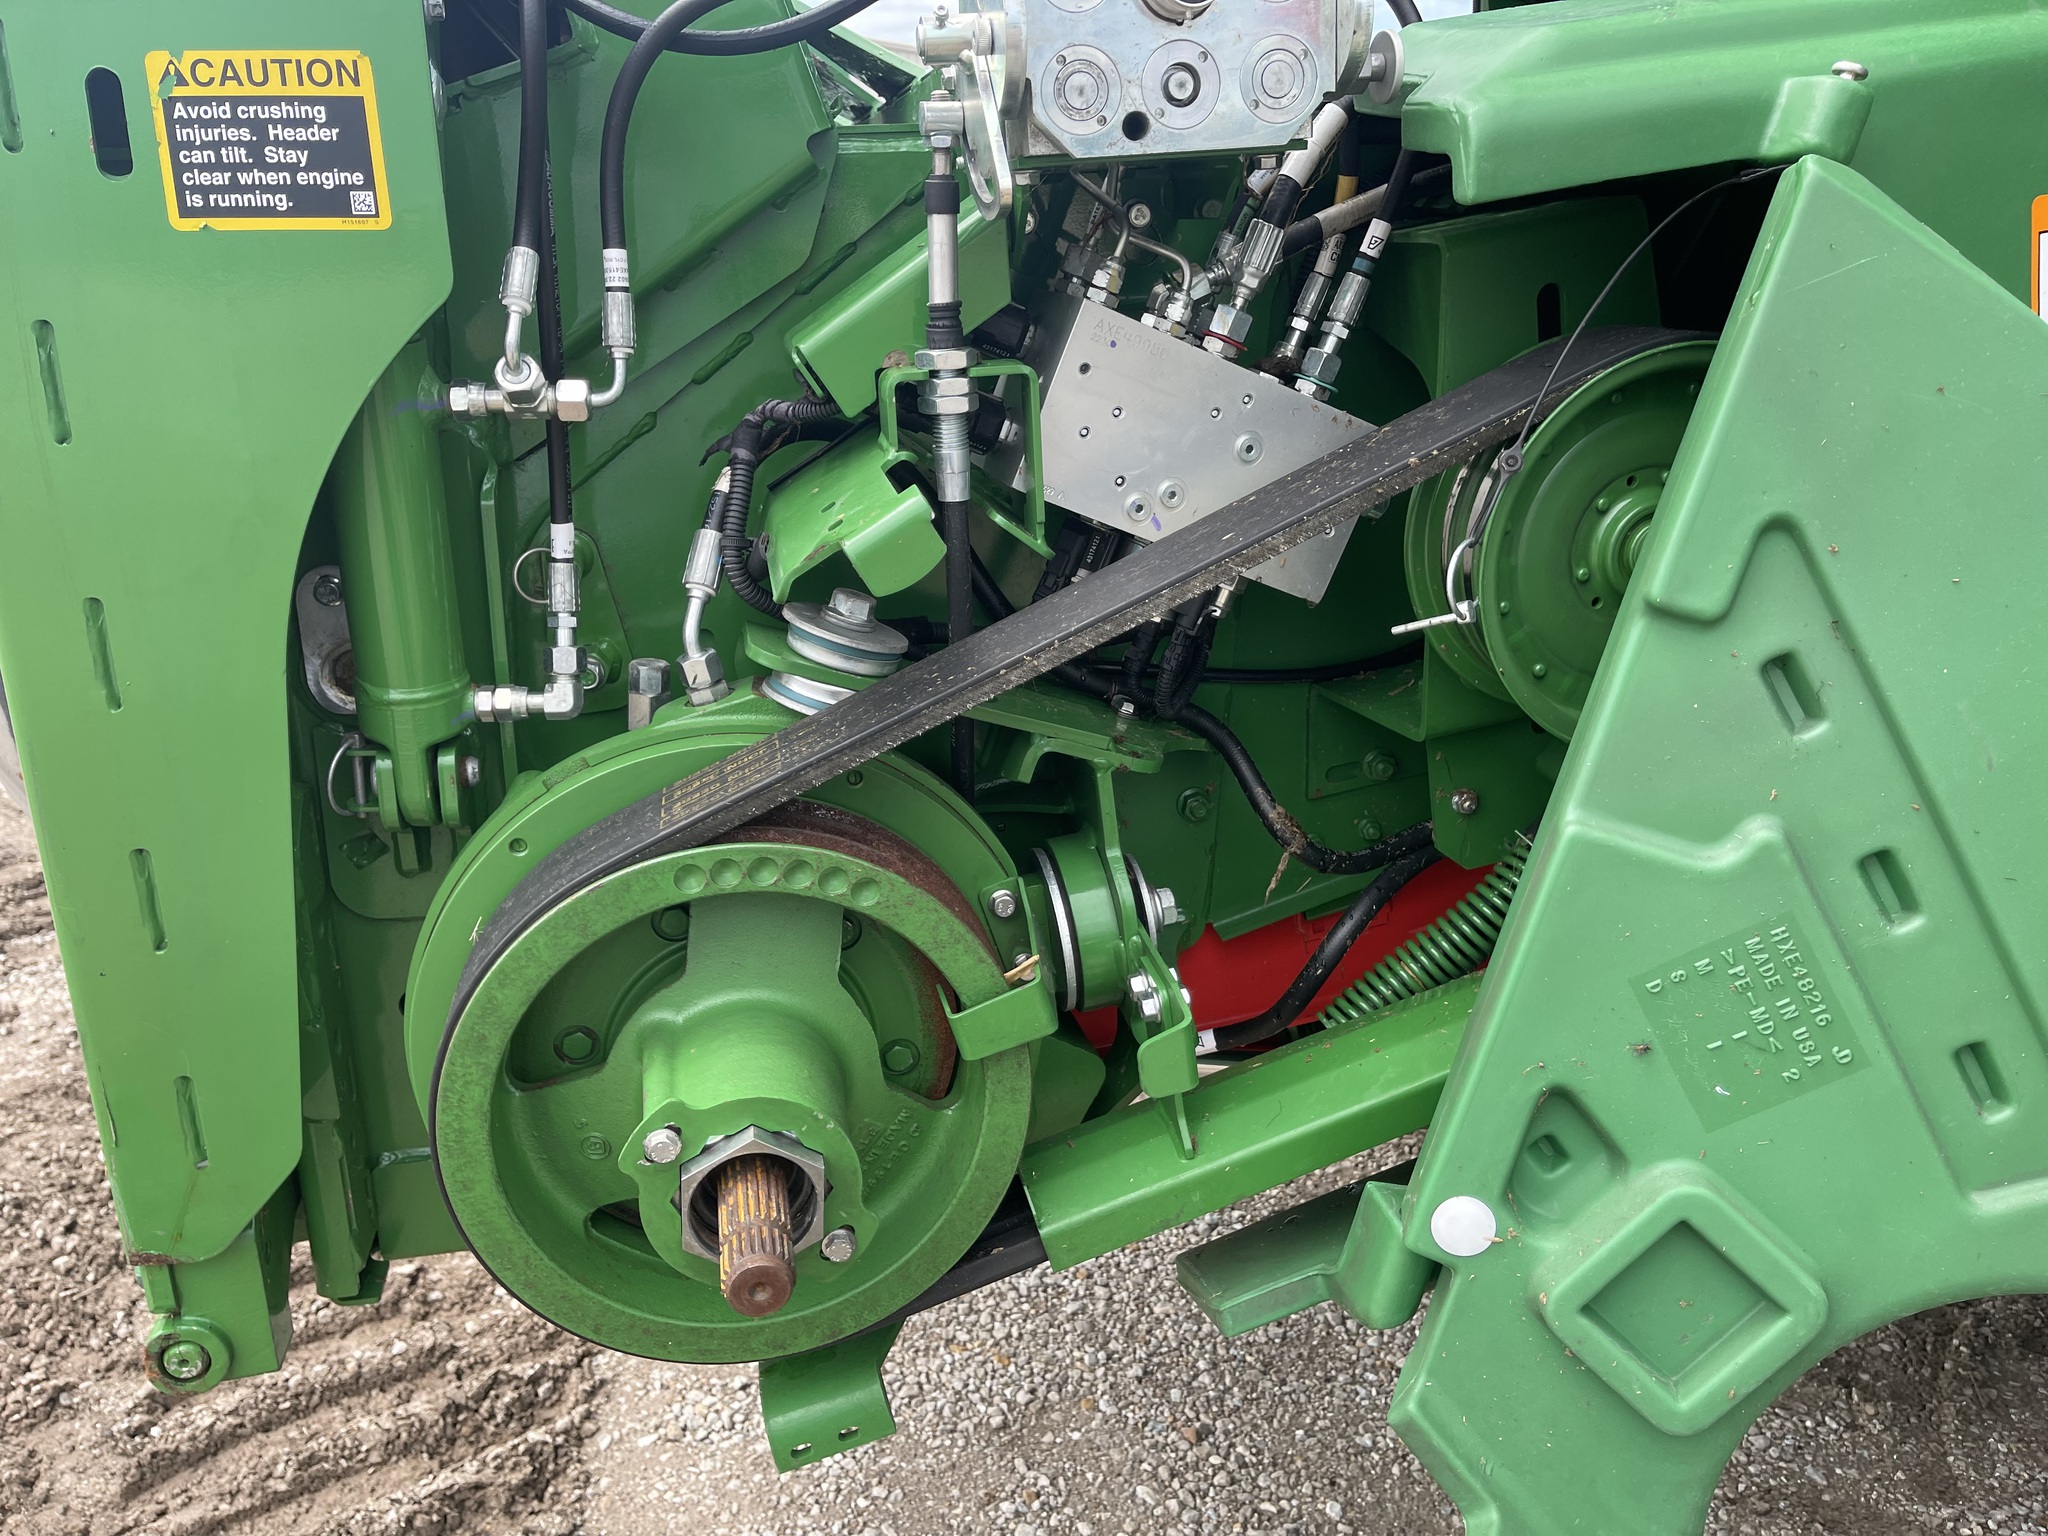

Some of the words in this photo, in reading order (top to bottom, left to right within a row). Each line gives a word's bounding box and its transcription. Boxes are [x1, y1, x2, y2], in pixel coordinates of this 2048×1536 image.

[189, 58, 361, 87] CAUTION
[172, 101, 232, 119] Avoid
[236, 101, 327, 123] crushing
[175, 124, 257, 145] injuries.
[267, 124, 340, 141] Header
[179, 149, 215, 164] can
[220, 146, 253, 164] tilt.
[264, 146, 308, 167] Stay
[182, 169, 231, 186] clear
[236, 169, 291, 185] when
[296, 169, 364, 190] engine
[185, 190, 203, 207] is
[209, 190, 294, 211] running.
[1693, 957, 1714, 975] M
[1769, 926, 1832, 1027] HXE48216
[1645, 978, 1663, 993] D
[1744, 936, 1784, 991] MADE
[1775, 997, 1800, 1021] IN
[1791, 1026, 1823, 1067] USA
[1781, 1068, 1801, 1083] 2
